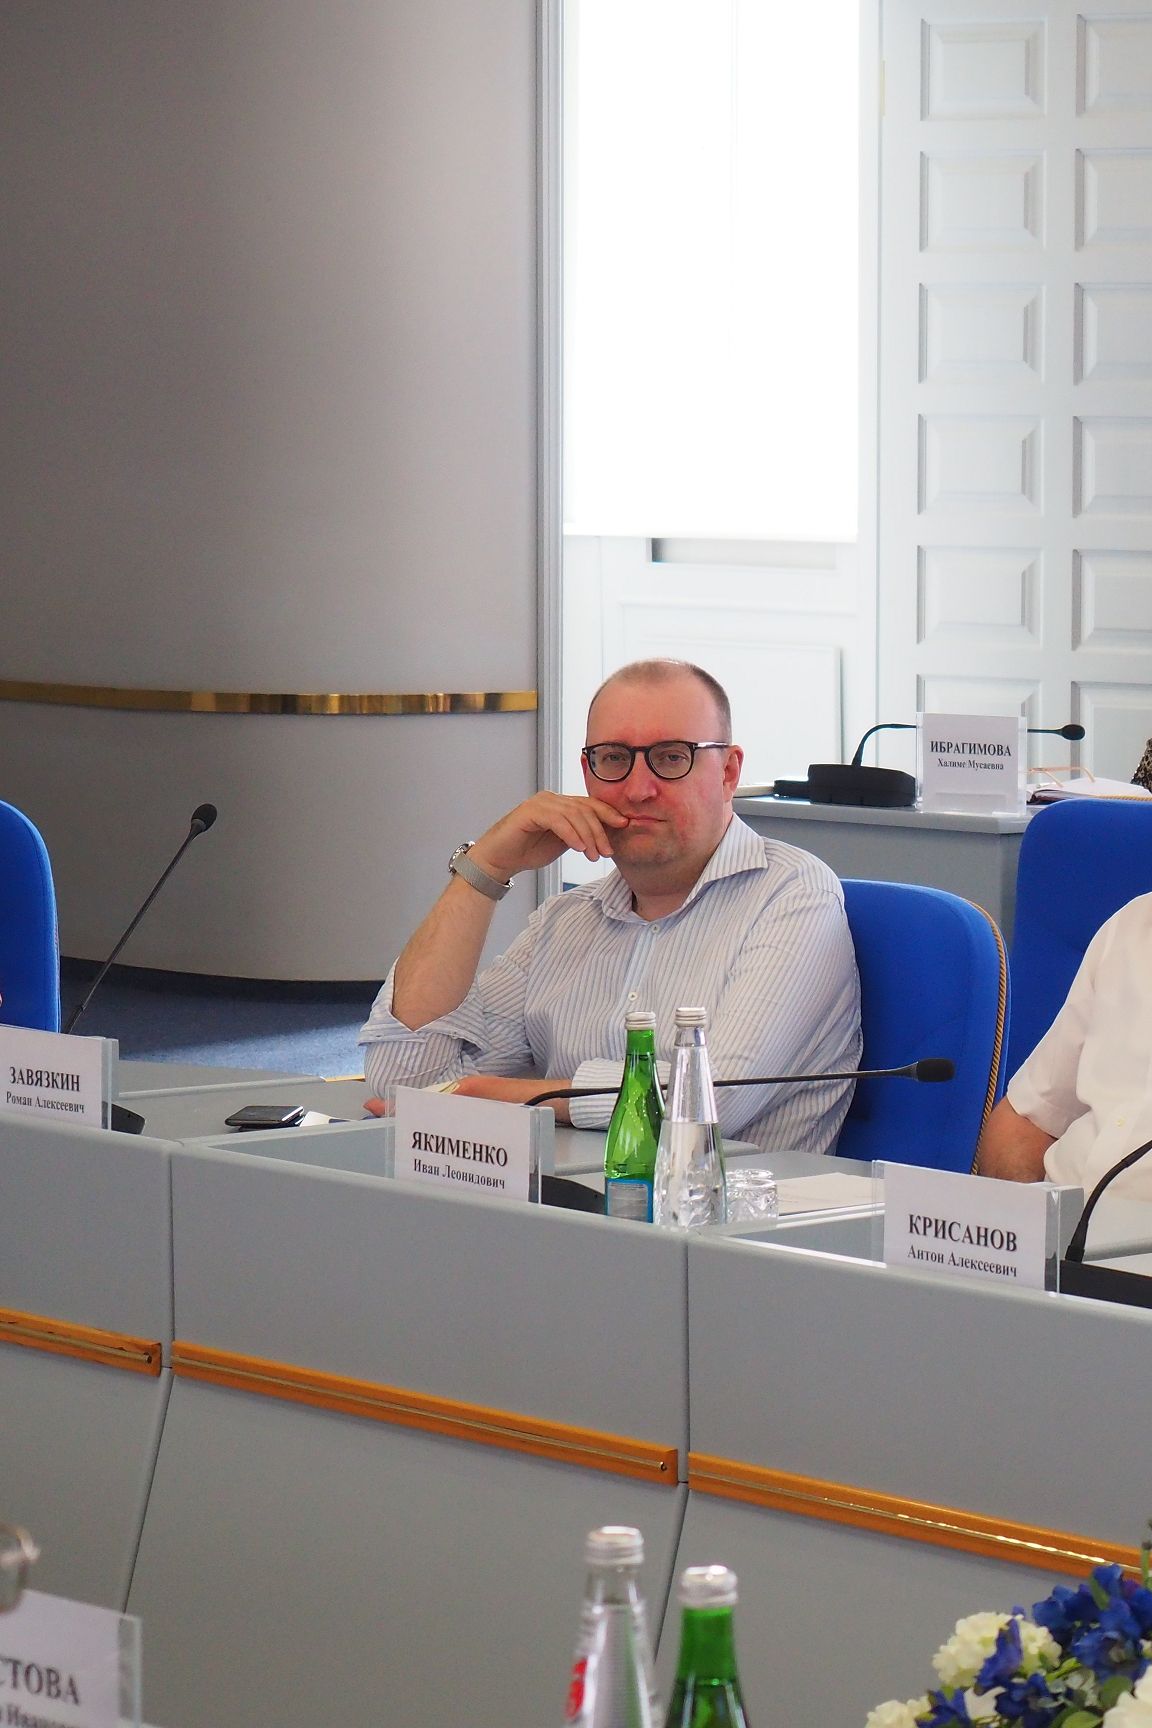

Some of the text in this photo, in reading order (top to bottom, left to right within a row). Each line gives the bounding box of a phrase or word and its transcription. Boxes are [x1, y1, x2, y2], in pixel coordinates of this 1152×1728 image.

[930, 740, 1012, 757] ИБРАГИМОВА
[937, 758, 1004, 771] Халиме Мусаевна
[9, 1066, 81, 1092] ЗАВЯЗКИН
[6, 1091, 85, 1114] Роман Алексеевич
[411, 1131, 508, 1167] ЯКИМЕНКО
[413, 1158, 505, 1190] Иван Леонидович
[908, 1213, 1018, 1253] КРИСАНОВ
[907, 1244, 1018, 1278] Антон Алексеевич
